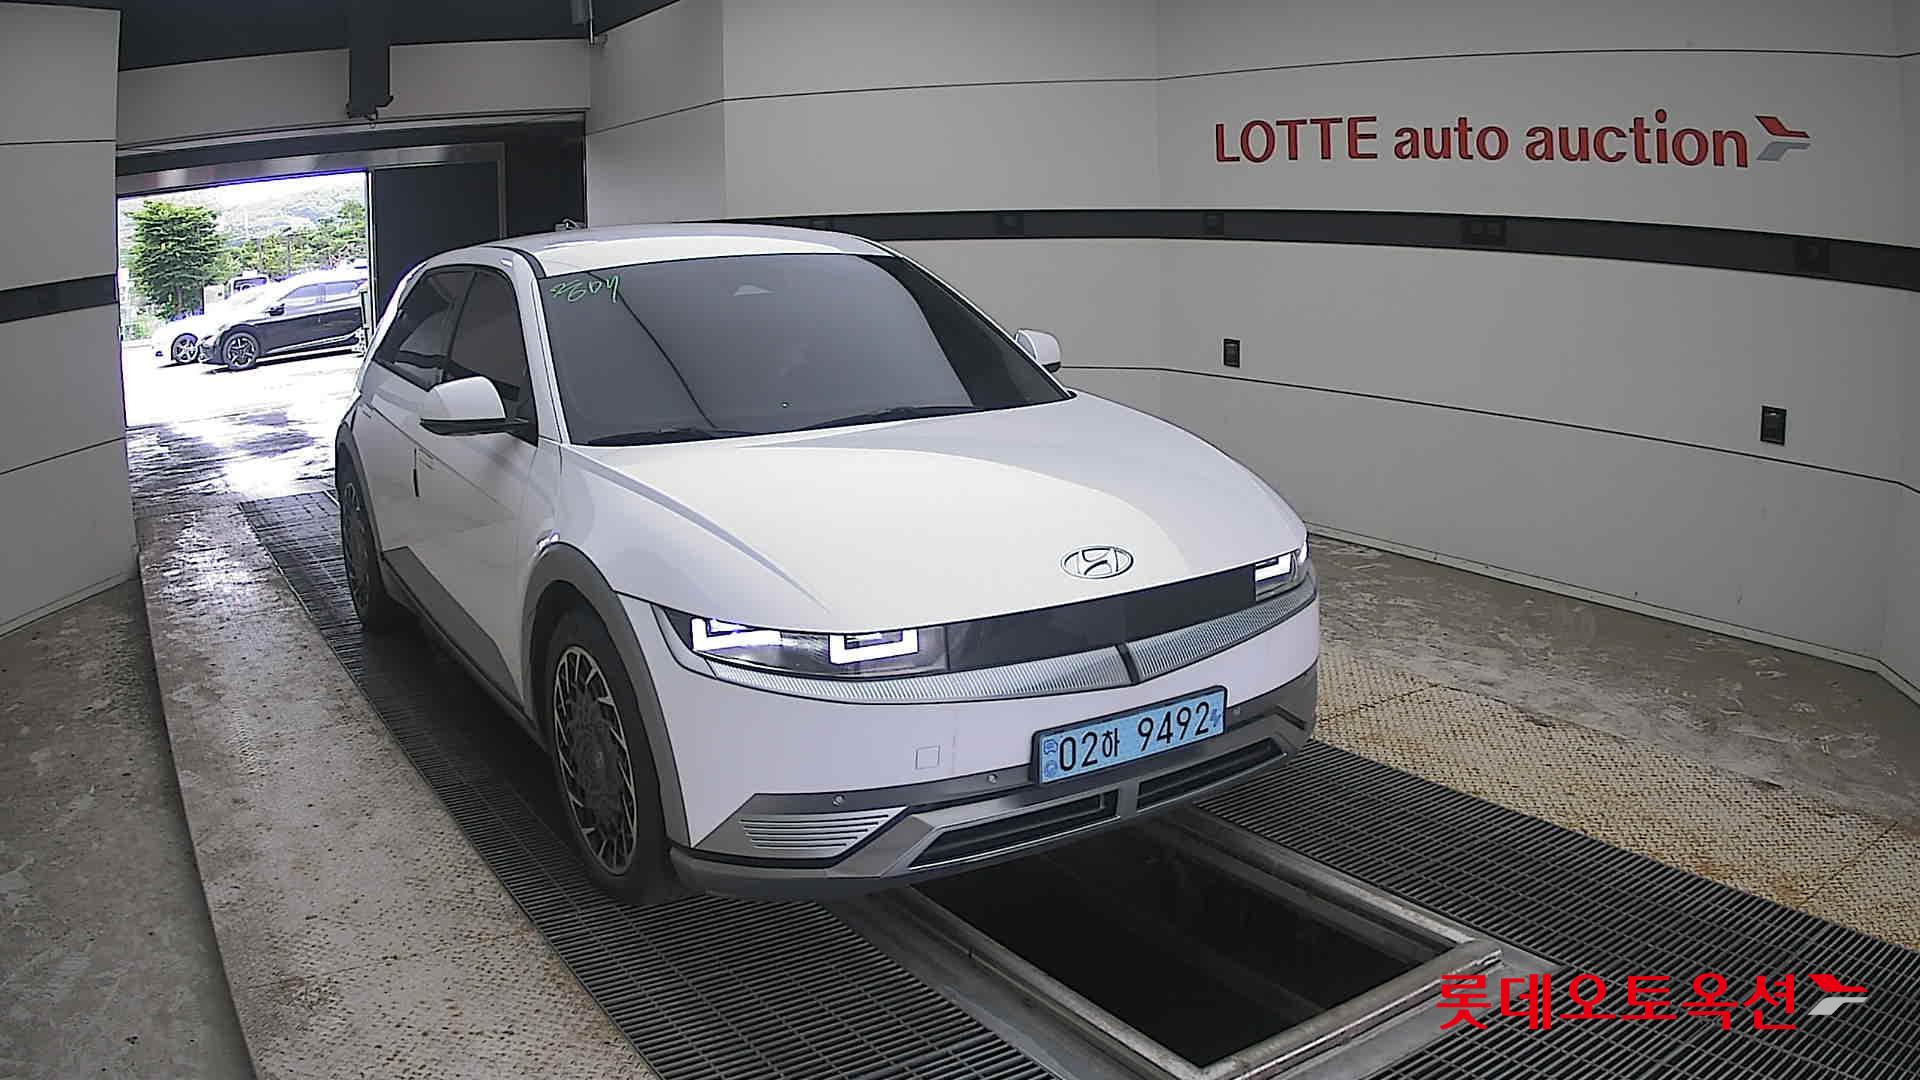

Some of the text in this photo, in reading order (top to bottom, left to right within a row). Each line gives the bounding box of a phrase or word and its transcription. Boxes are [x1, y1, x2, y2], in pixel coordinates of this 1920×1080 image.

[1215, 108, 1749, 168] LOTTE auto auction
[1059, 702, 1210, 771] 02하 9492
